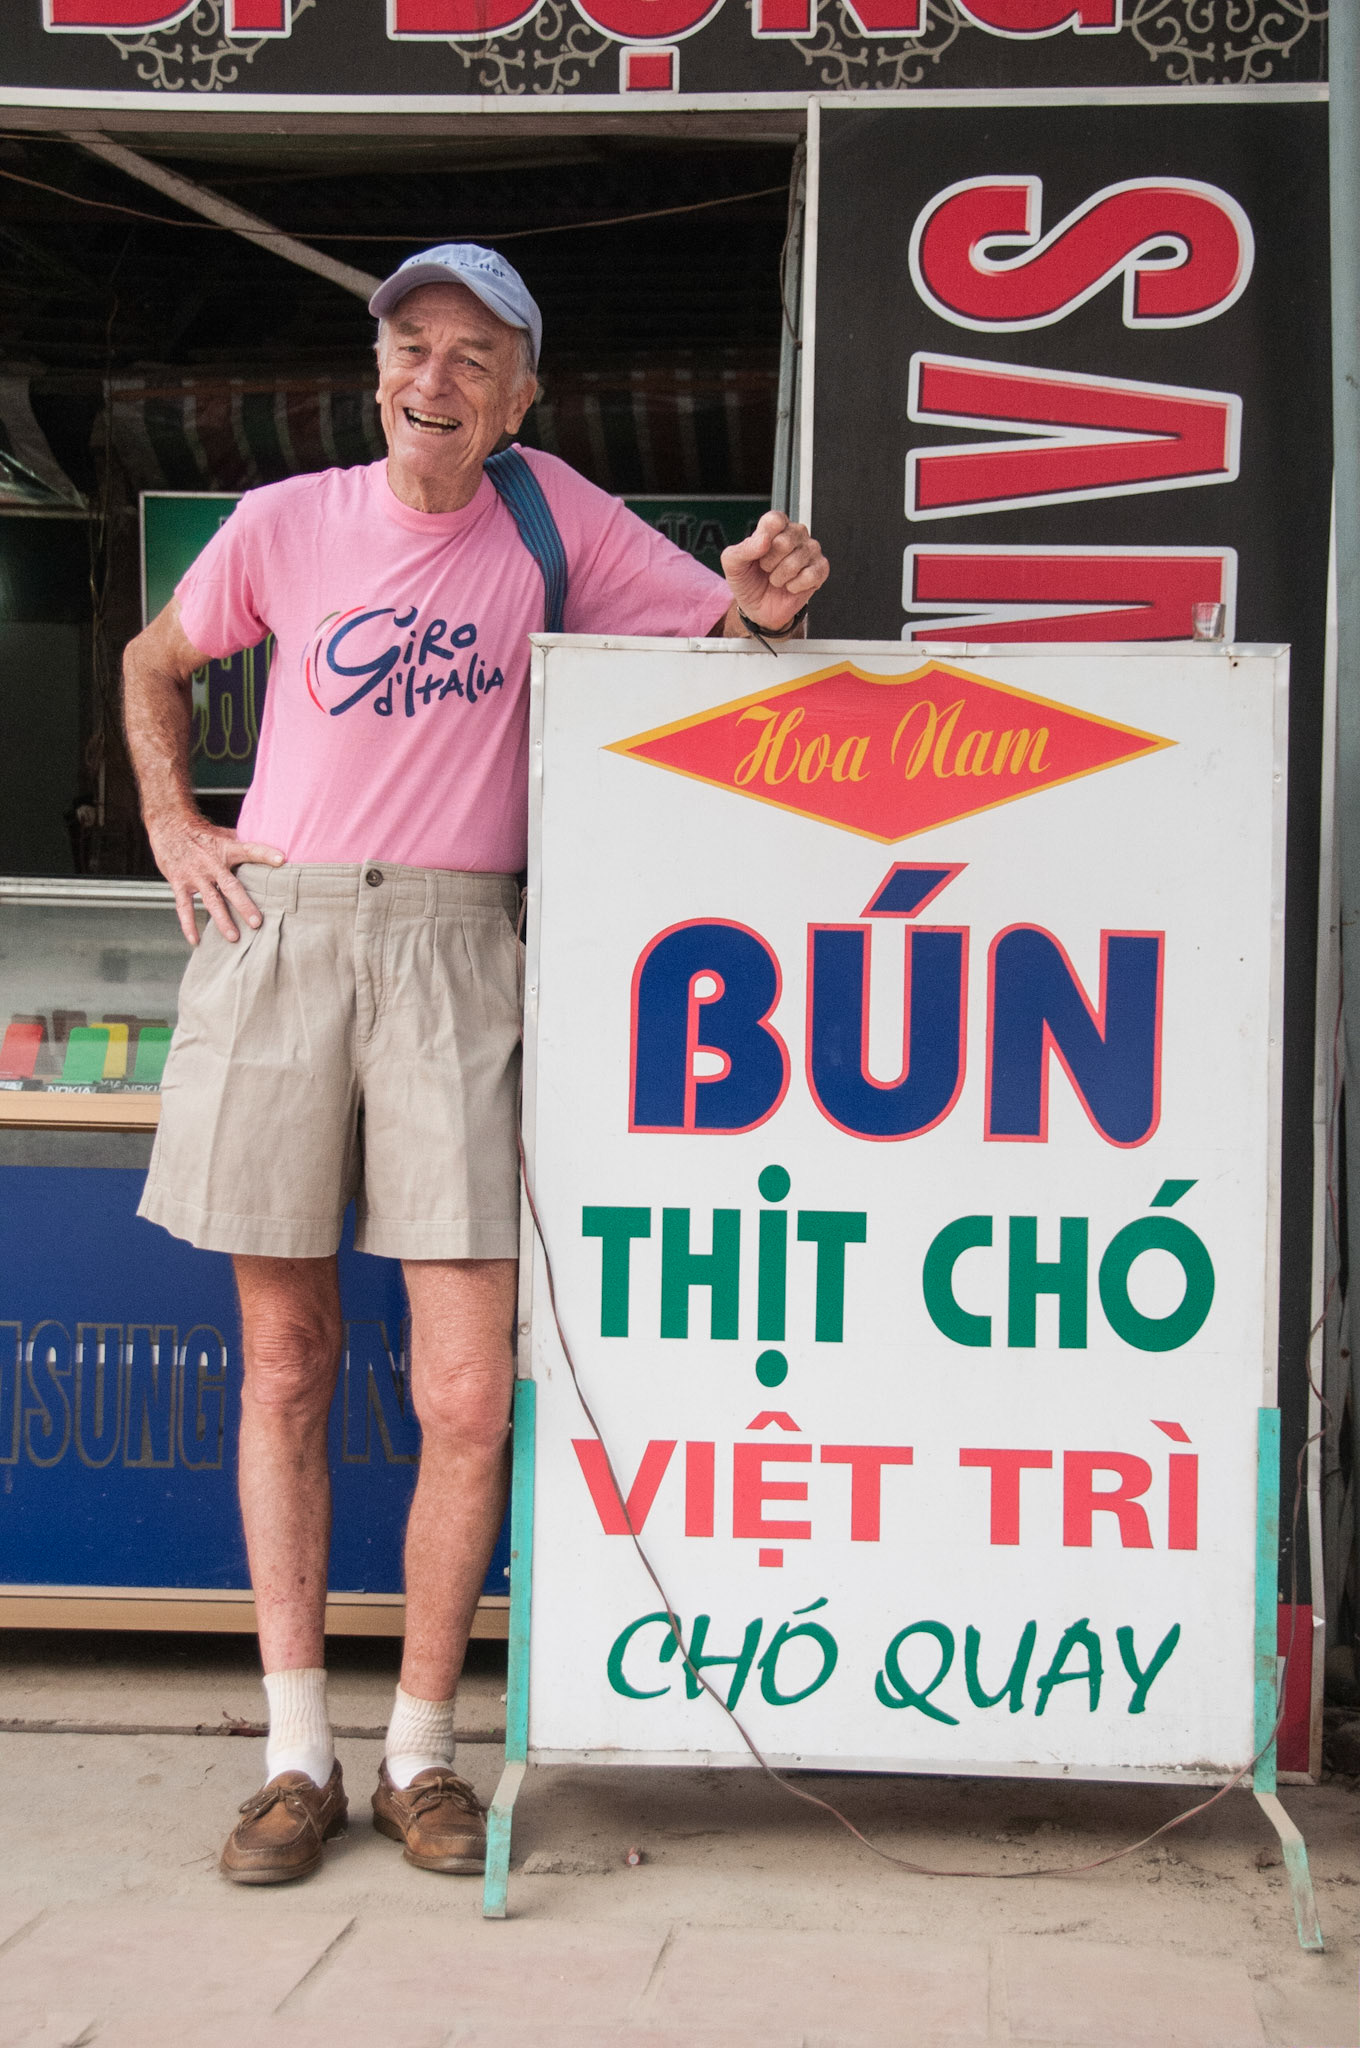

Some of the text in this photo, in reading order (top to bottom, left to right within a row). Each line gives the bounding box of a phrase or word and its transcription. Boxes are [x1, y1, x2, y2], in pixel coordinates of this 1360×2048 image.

[734, 699, 1052, 786] Hoa Nam
[628, 861, 1166, 1150] BÚN
[581, 1164, 1216, 1388] THỊT CHÓ
[571, 1410, 1199, 1568] VIỆT TRÌ
[606, 1597, 1181, 1726] CHÓ QUAY
